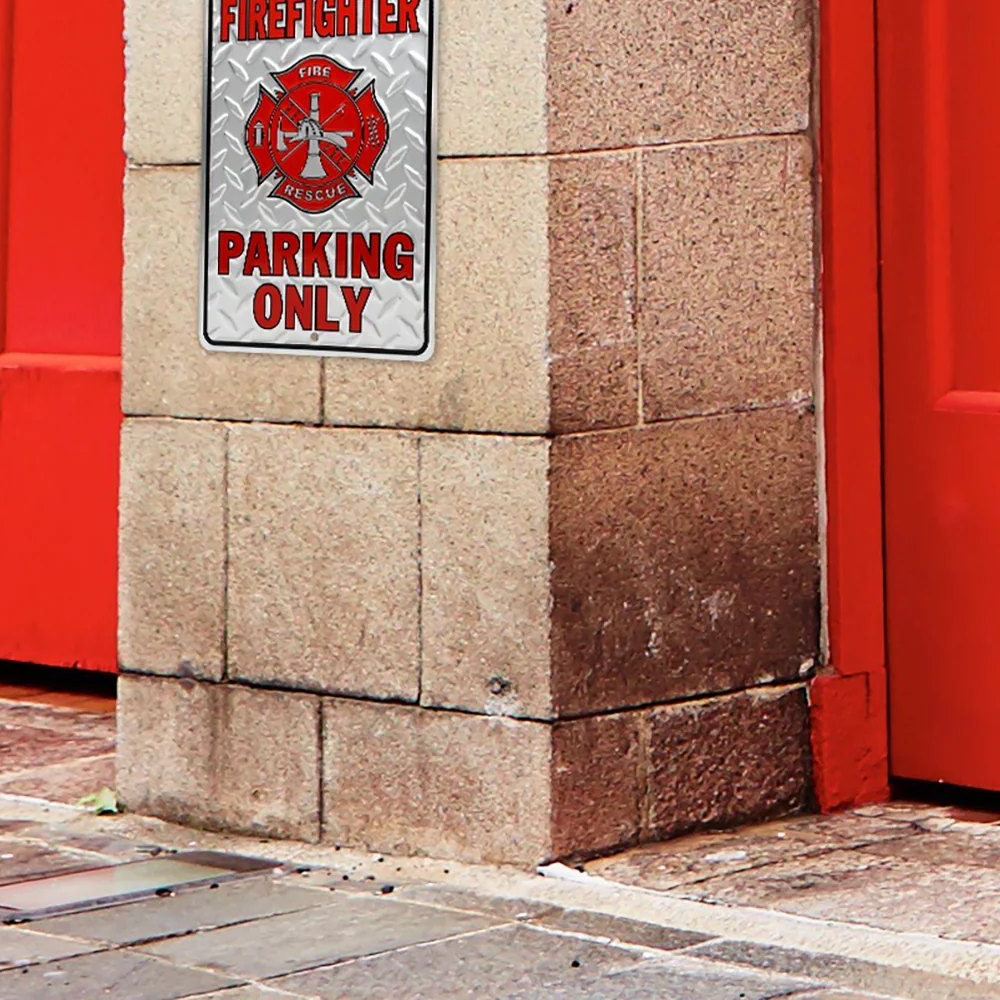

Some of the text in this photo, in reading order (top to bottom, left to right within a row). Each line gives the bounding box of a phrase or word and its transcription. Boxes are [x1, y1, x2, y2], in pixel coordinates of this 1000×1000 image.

[298, 66, 332, 79] FIRE
[284, 184, 348, 202] RESCUE
[218, 231, 415, 281] PARKING
[253, 283, 373, 333] ONLY
